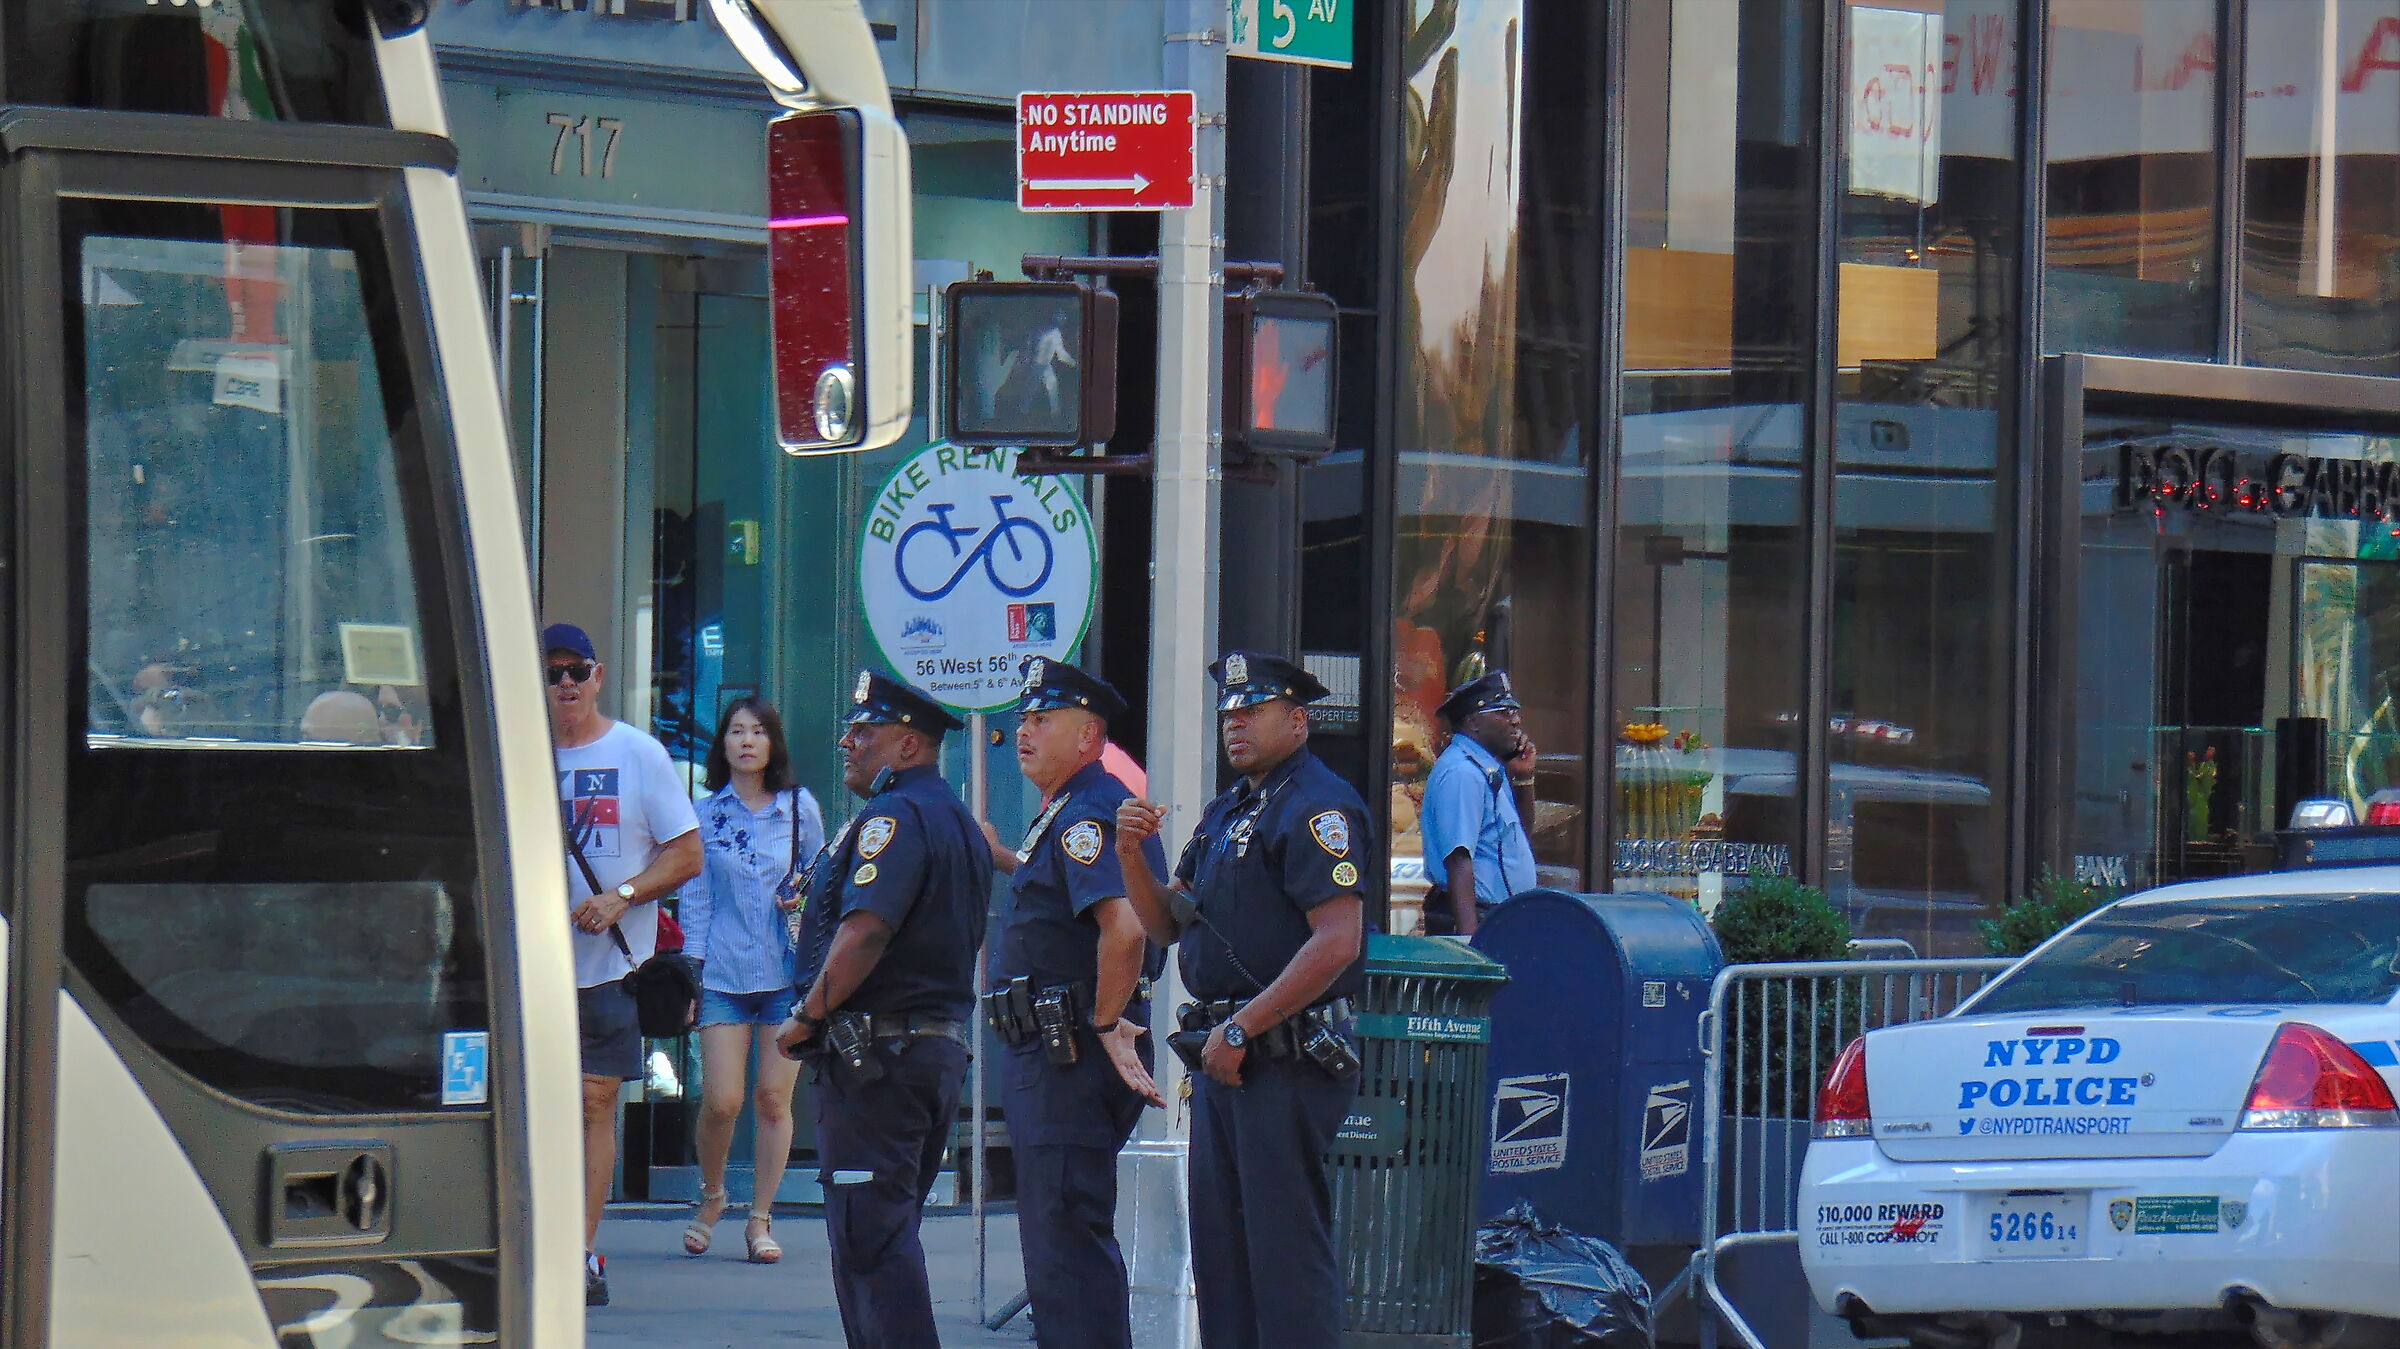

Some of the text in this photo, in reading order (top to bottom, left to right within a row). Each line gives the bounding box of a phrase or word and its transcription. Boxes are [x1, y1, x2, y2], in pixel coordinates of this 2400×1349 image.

[1272, 0, 1338, 48] 5 AV
[1028, 104, 1167, 126] NO STANDING
[546, 112, 624, 178] 717
[1029, 130, 1117, 157] Anytime
[870, 461, 931, 544] BIKE
[916, 659, 935, 676] 56
[940, 657, 983, 675] West
[930, 681, 971, 692] Between
[987, 679, 994, 688] &
[1309, 709, 1359, 721] ROPERTIES
[587, 774, 606, 791] N
[1407, 1016, 1481, 1033] Fifth Avenue
[1984, 1038, 2120, 1067] NYPD
[1958, 1078, 2138, 1109] POLICE
[1350, 1131, 1377, 1140] District
[1979, 1117, 2131, 1135] @NYPDTRANSPORT
[1493, 1143, 1558, 1157] UNITED STATES
[1491, 1153, 1561, 1169] POSTAL SERVICE
[1818, 1203, 1944, 1225] $10,000 REWARD
[1990, 1211, 2076, 1242] 5266 14
[1820, 1232, 1838, 1245] CALL
